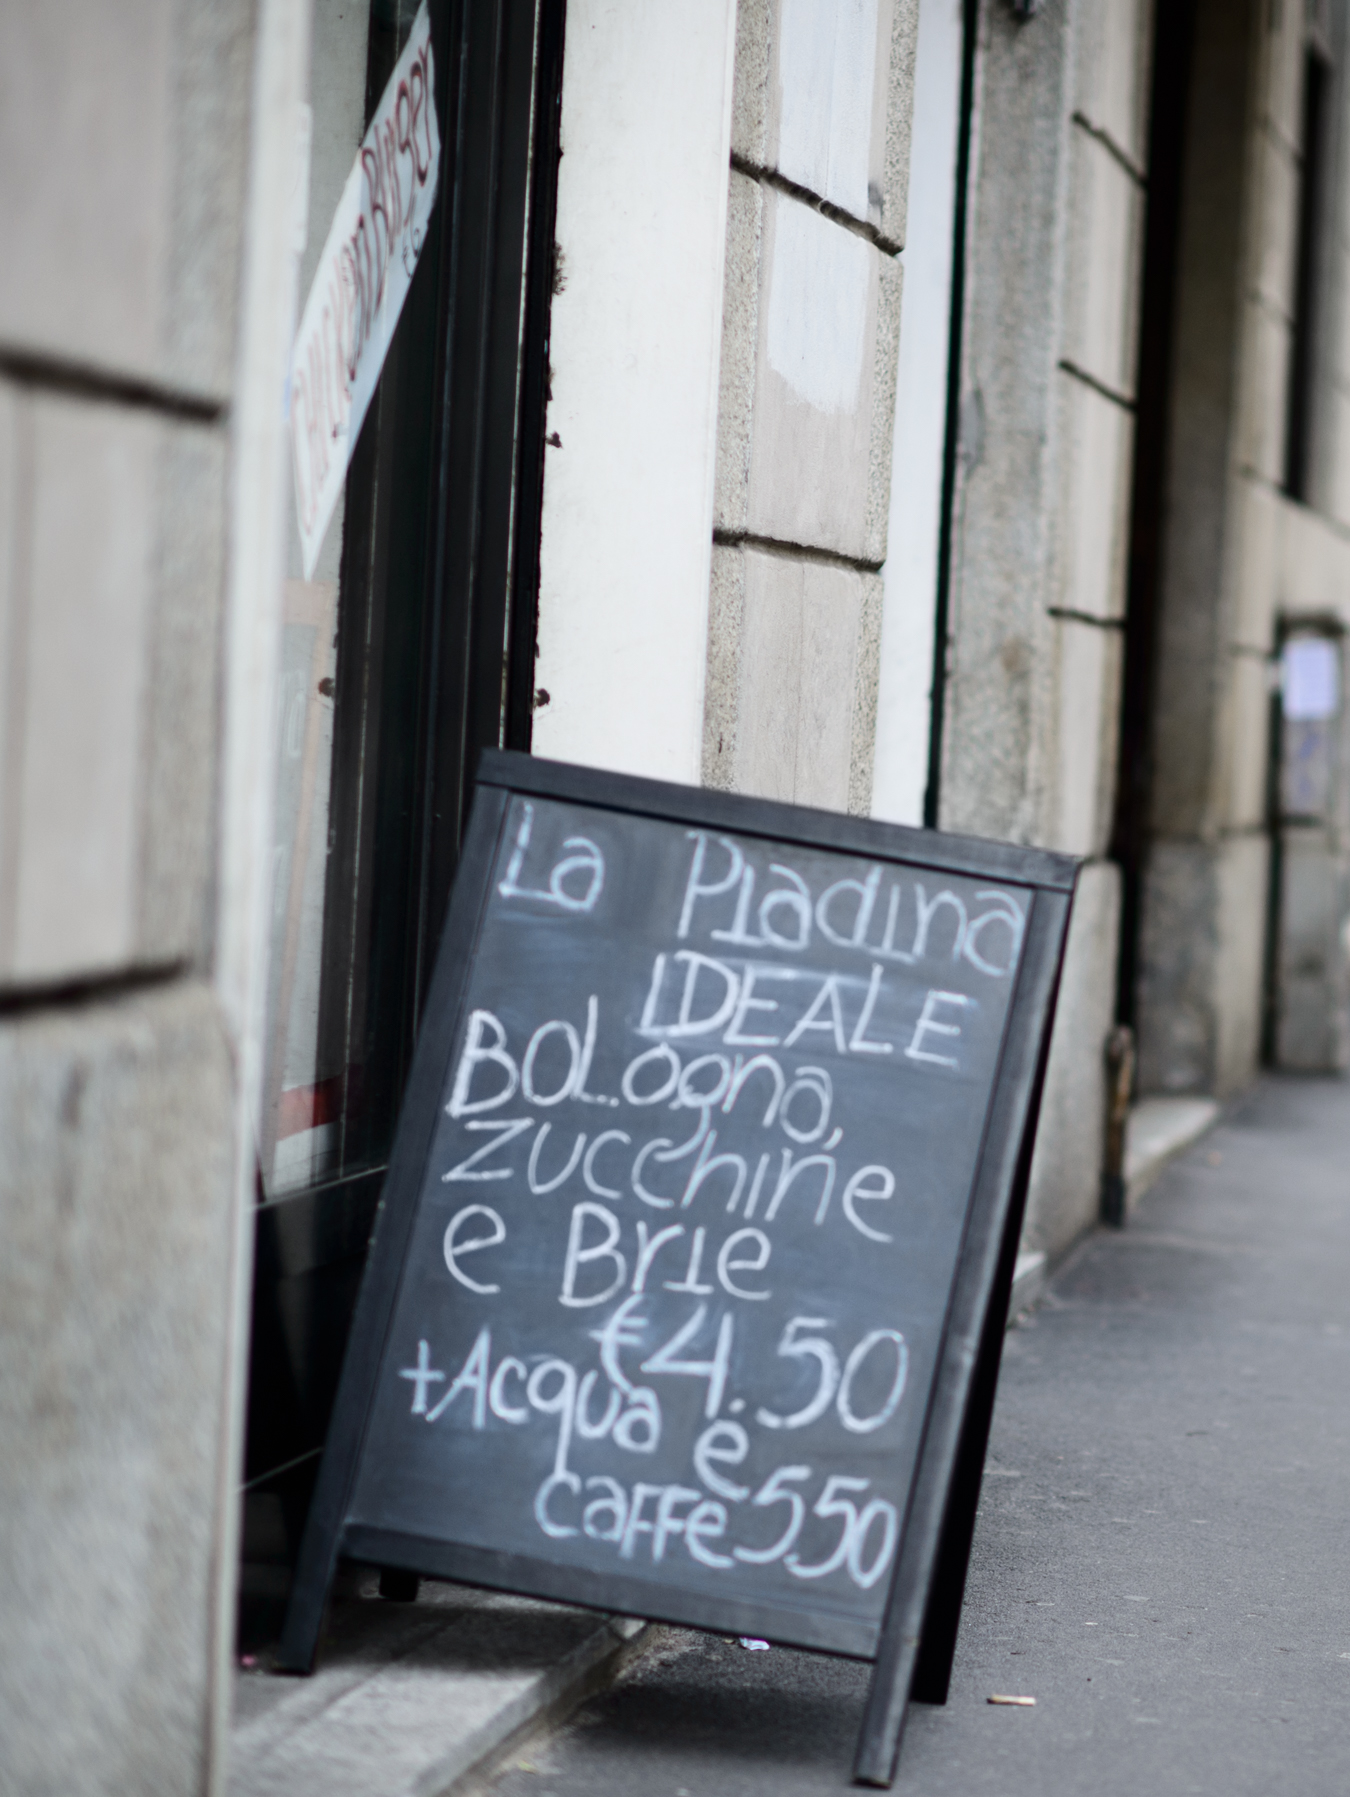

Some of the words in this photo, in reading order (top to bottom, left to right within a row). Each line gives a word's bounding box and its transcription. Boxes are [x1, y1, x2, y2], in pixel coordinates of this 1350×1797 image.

[499, 804, 604, 911] La
[636, 952, 969, 1068] IDEALE
[443, 1205, 506, 1294] e
[557, 1200, 772, 1308] Brie
